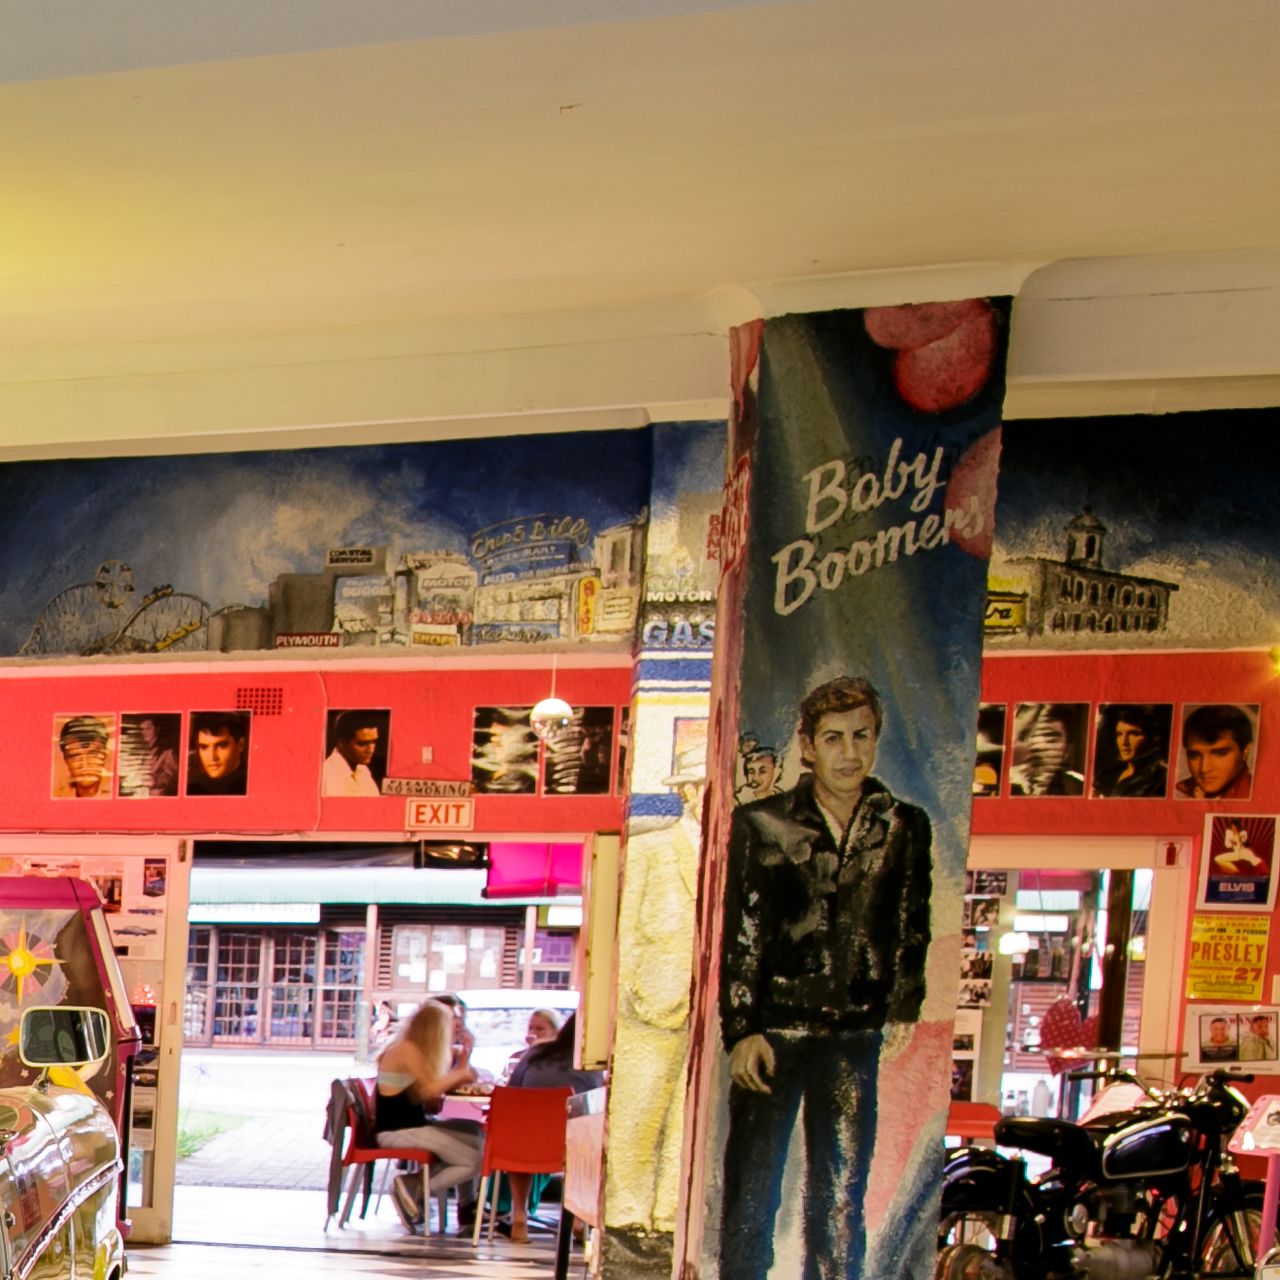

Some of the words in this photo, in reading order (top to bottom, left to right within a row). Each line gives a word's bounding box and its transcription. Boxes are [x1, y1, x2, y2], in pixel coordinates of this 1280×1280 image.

[802, 437, 946, 534] Baby
[706, 514, 720, 561] BANK
[771, 496, 985, 616] Boomers
[646, 590, 713, 603] MOTOR
[276, 635, 338, 646] PLYMOUTH
[642, 619, 716, 645] GAS
[386, 784, 403, 793] NO
[406, 784, 466, 796] SMOKING
[415, 804, 465, 824] EXIT
[1219, 882, 1255, 893] ELVIS
[1191, 942, 1265, 963] PRESLEY
[1235, 967, 1263, 981] 27
